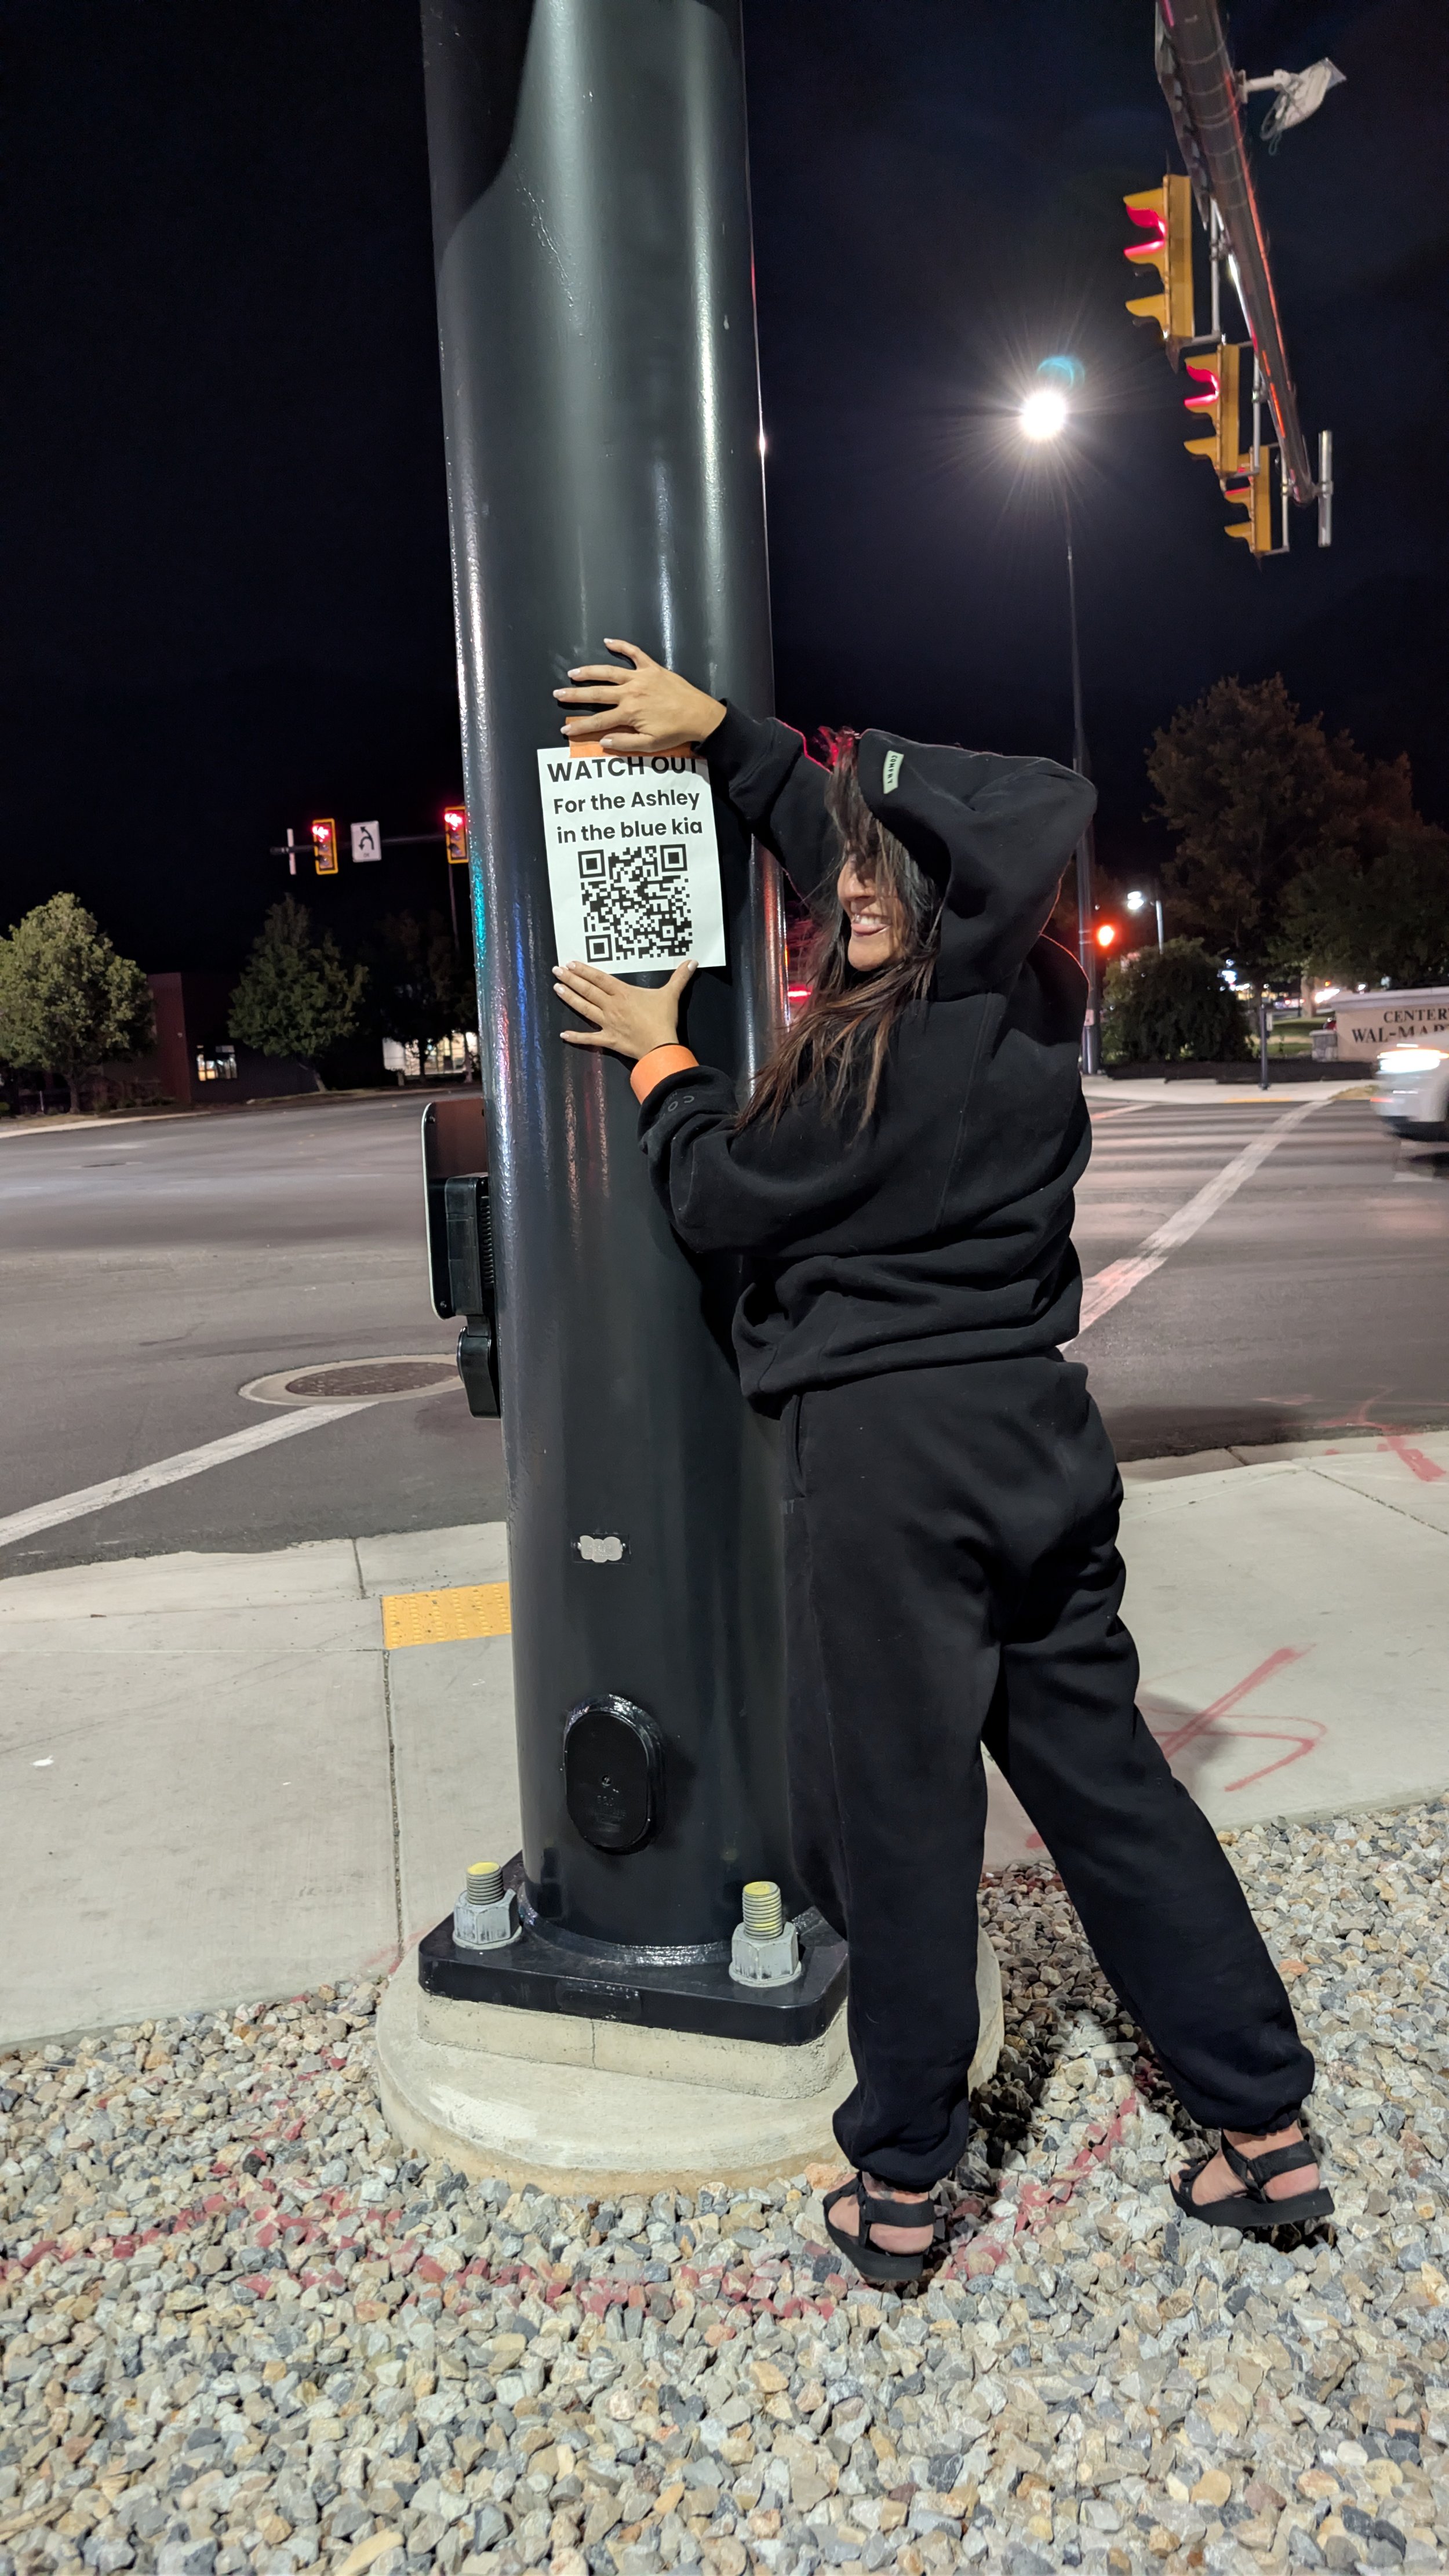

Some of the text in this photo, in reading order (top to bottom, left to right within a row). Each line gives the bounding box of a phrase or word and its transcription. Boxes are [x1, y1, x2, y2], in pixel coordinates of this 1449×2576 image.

[547, 756, 645, 783] WATCH
[554, 789, 700, 814] For the Ashley
[557, 817, 702, 843] in the blue kia
[1383, 1008, 1449, 1024] CENTER
[1351, 1023, 1449, 1043] WAL-MAR
